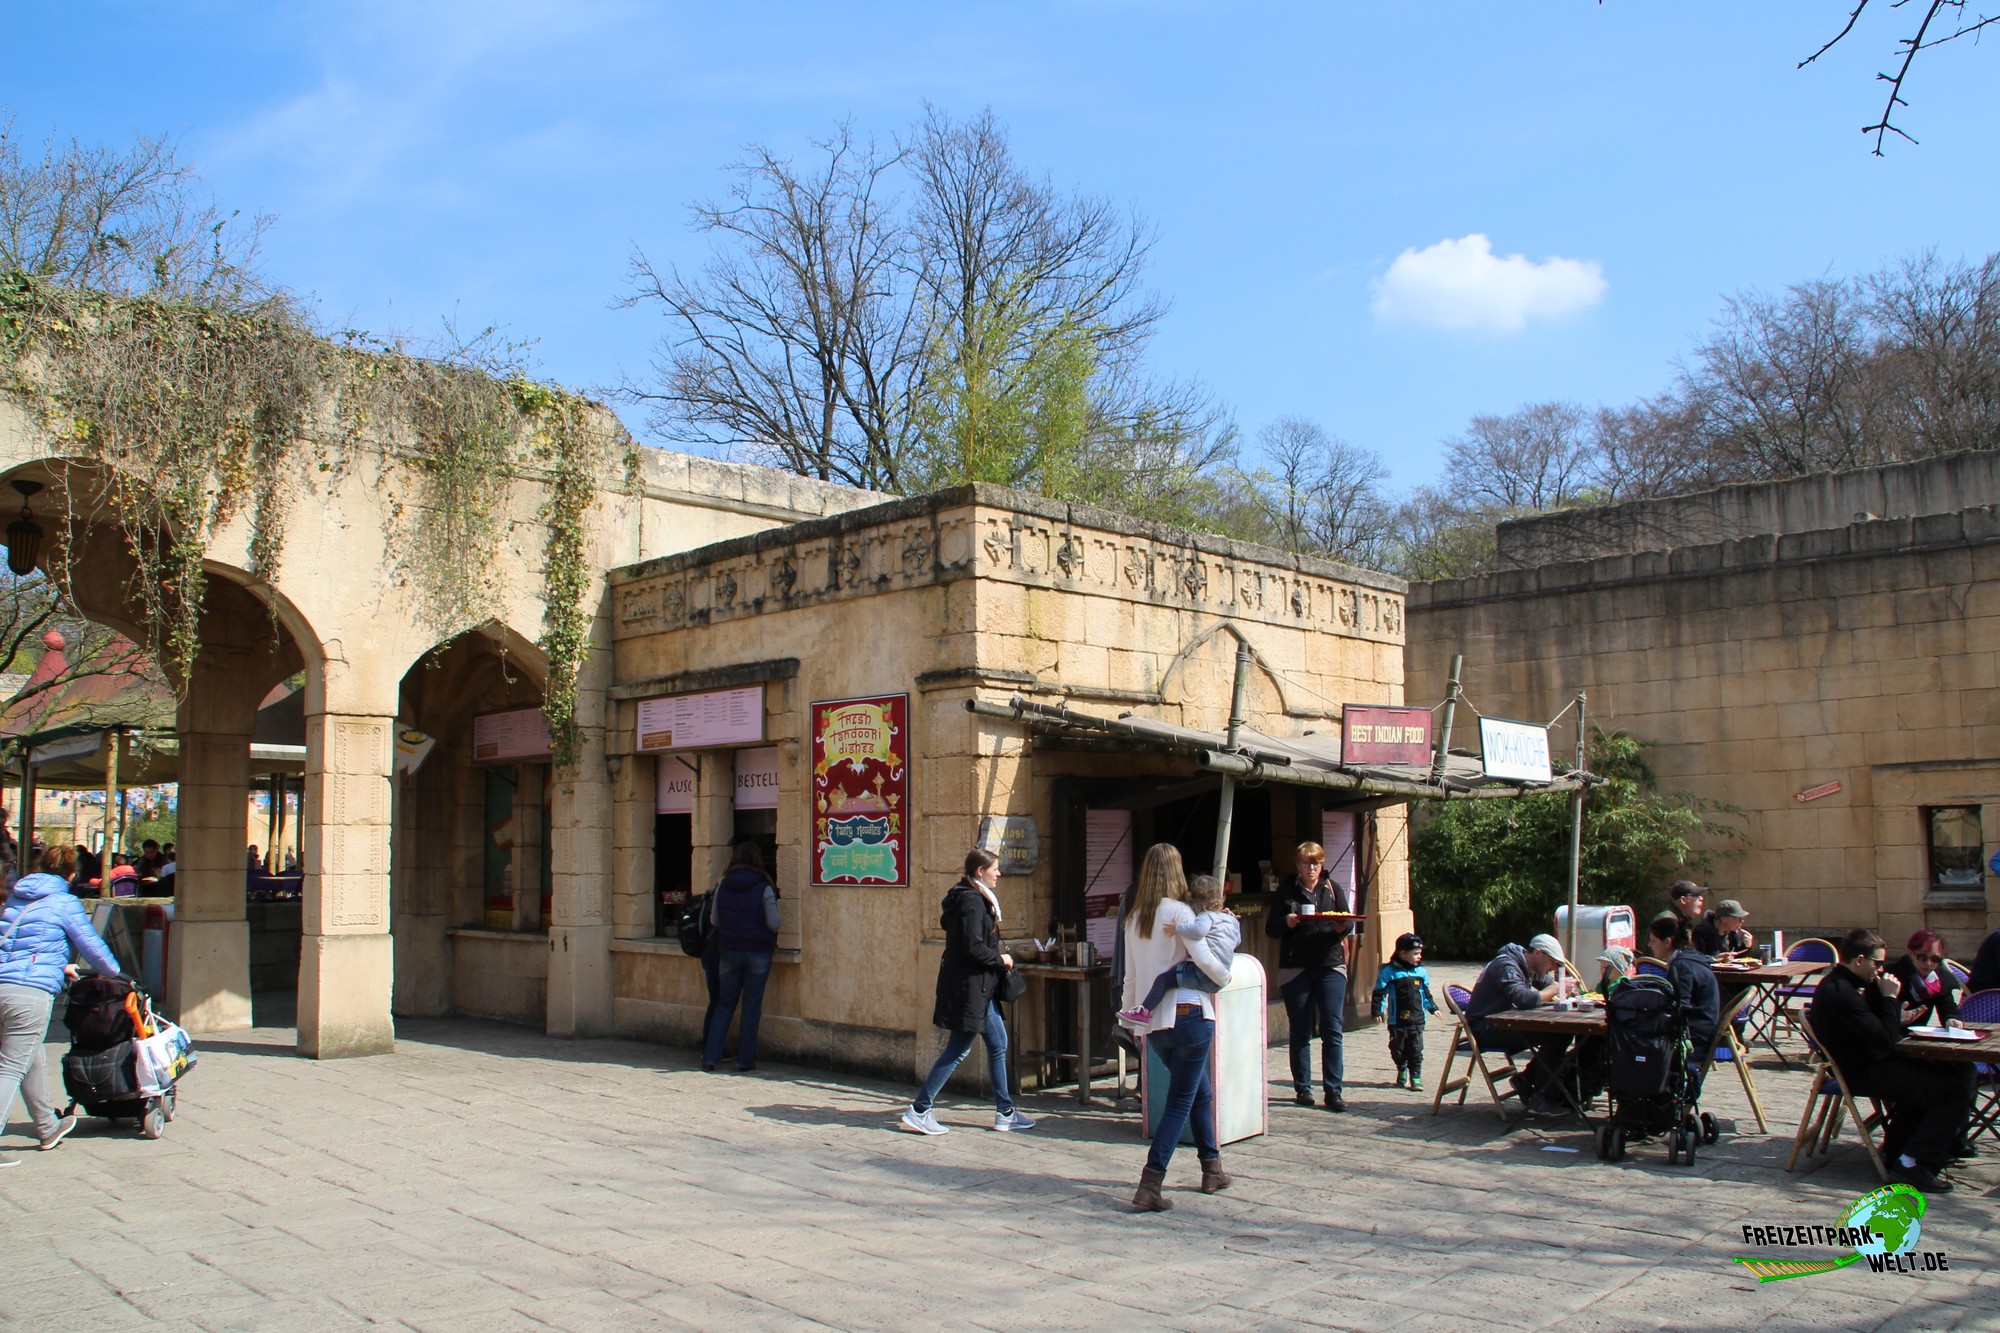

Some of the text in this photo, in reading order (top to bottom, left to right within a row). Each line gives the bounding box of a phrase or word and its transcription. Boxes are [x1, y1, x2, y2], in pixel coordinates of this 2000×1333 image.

[1351, 724, 1425, 744] BEST INDIAN FOOD
[1485, 730, 1548, 768] WOK-KÜCHE
[835, 824, 853, 838] tasty
